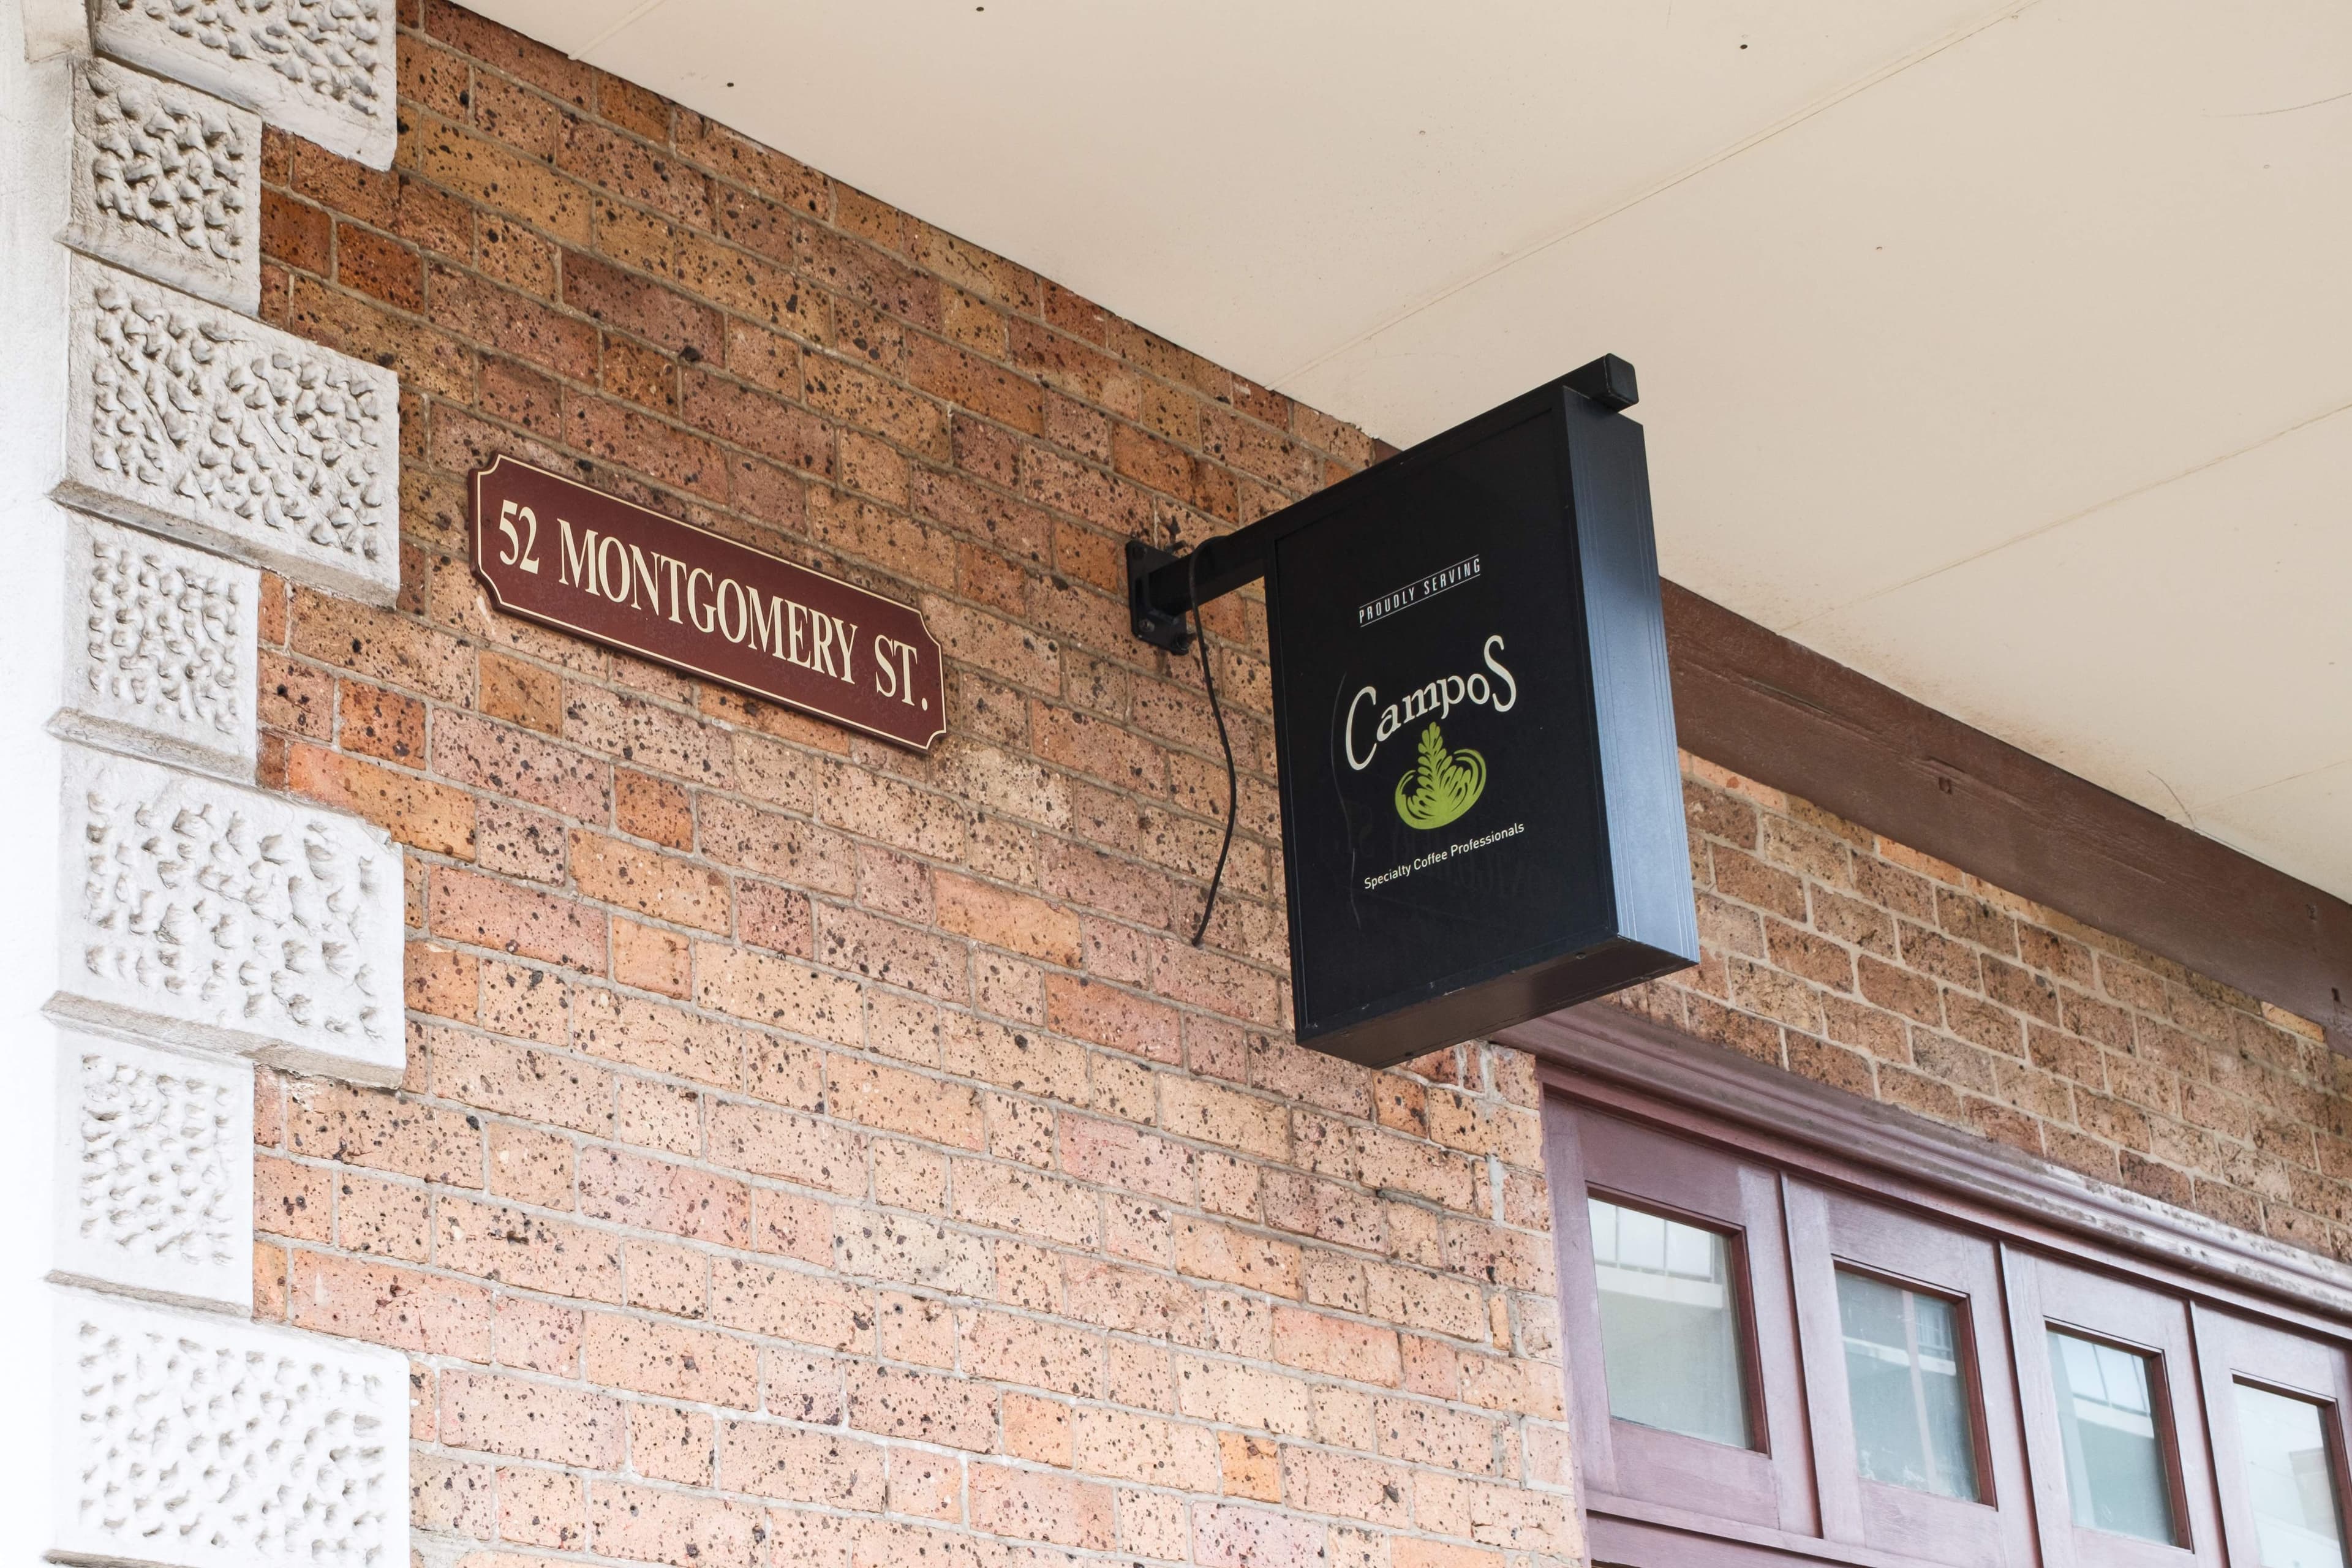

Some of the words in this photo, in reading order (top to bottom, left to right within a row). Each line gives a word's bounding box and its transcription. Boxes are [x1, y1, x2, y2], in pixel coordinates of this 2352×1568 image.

[499, 499, 540, 575] 52
[557, 518, 858, 685] MONTGOMERY
[875, 635, 928, 711] ST.
[1359, 586, 1415, 625] PROUDLY
[1423, 558, 1481, 596] SERVING
[1364, 864, 1412, 890] Specialty
[1413, 850, 1448, 871] Coffee
[1450, 822, 1525, 858] Professionals
